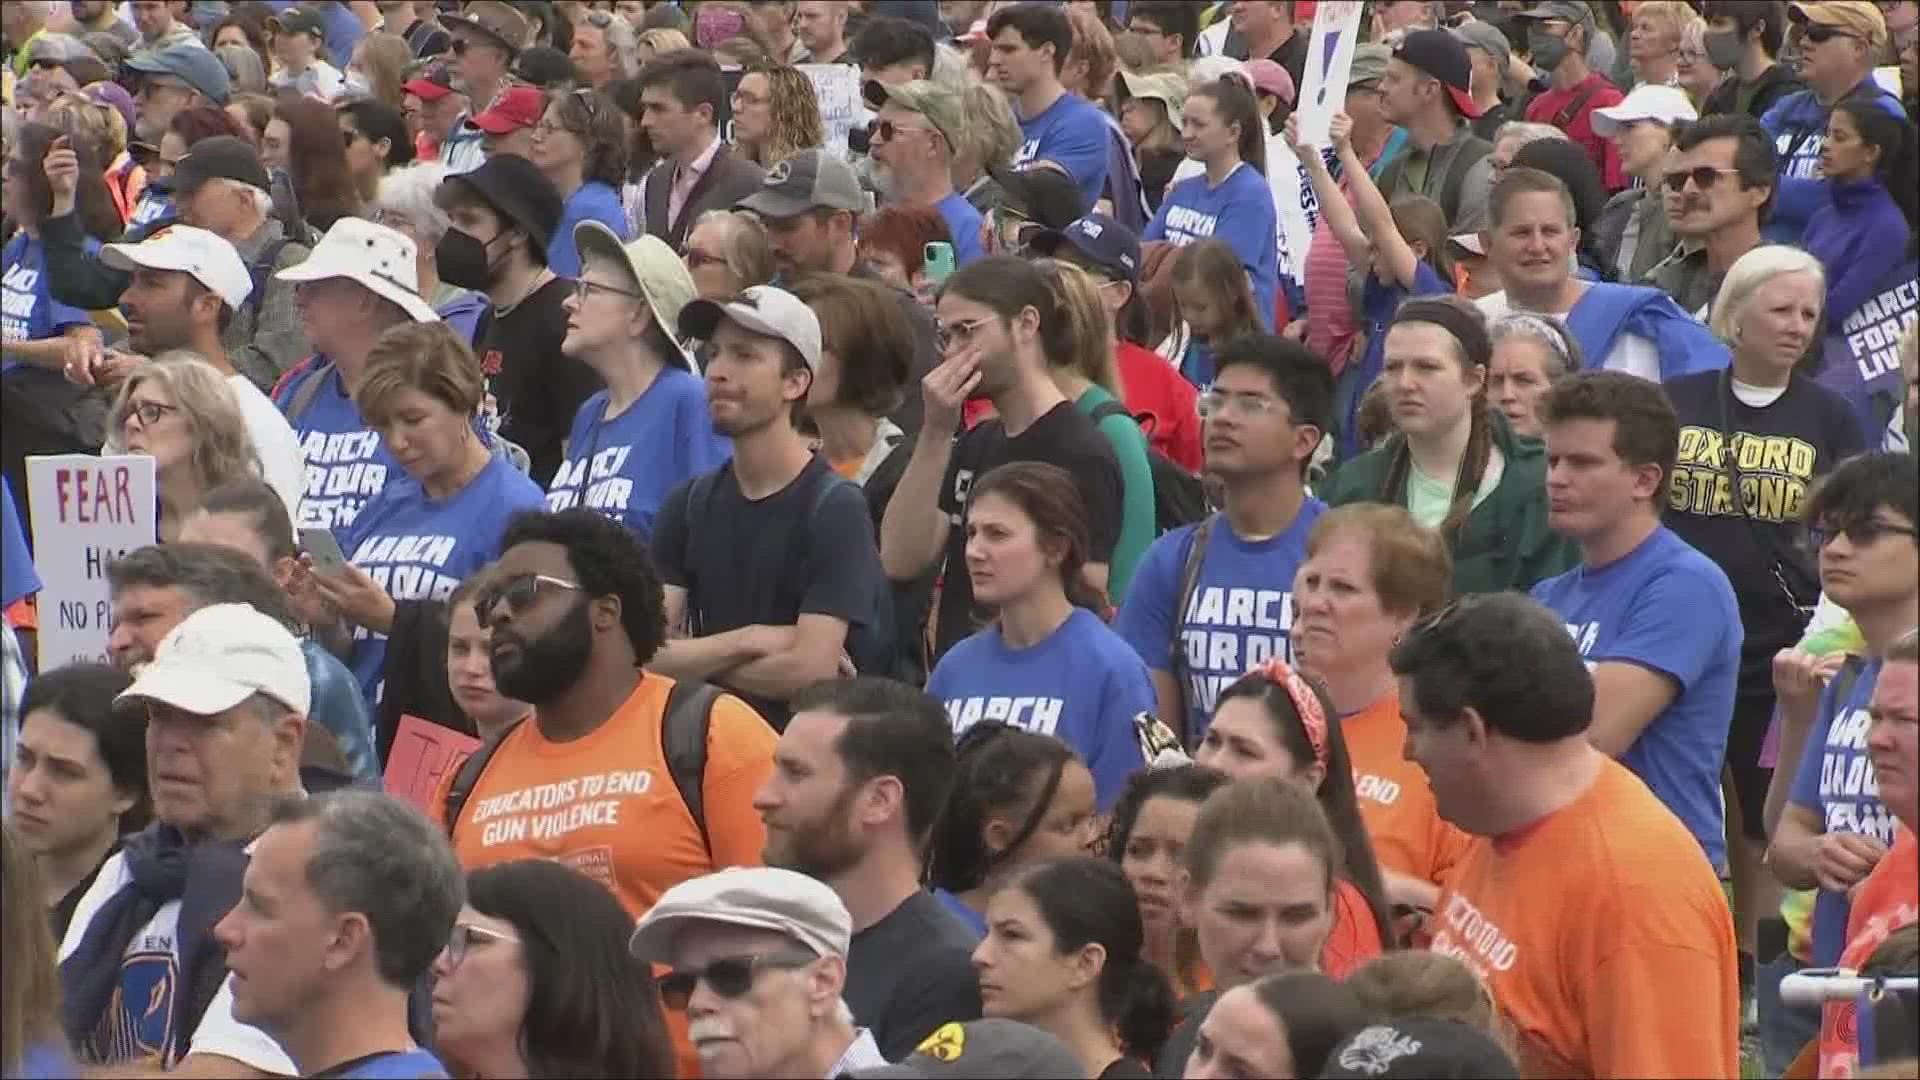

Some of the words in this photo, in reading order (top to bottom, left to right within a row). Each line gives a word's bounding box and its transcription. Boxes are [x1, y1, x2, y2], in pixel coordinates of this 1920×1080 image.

[1848, 318, 1903, 358] FOR
[1858, 345, 1901, 381] LIV
[56, 466, 135, 524] FEAR
[324, 464, 388, 497] OUR
[1669, 469, 1808, 522] STRONG
[352, 535, 457, 568] MARCH
[60, 601, 88, 631] NO
[1246, 634, 1299, 673] OU
[472, 779, 580, 824] EDUCATORS
[580, 773, 604, 796] TO
[606, 770, 652, 793] END
[1356, 774, 1400, 804] END
[482, 815, 529, 847] GUN
[530, 800, 620, 841] VIOLENCE
